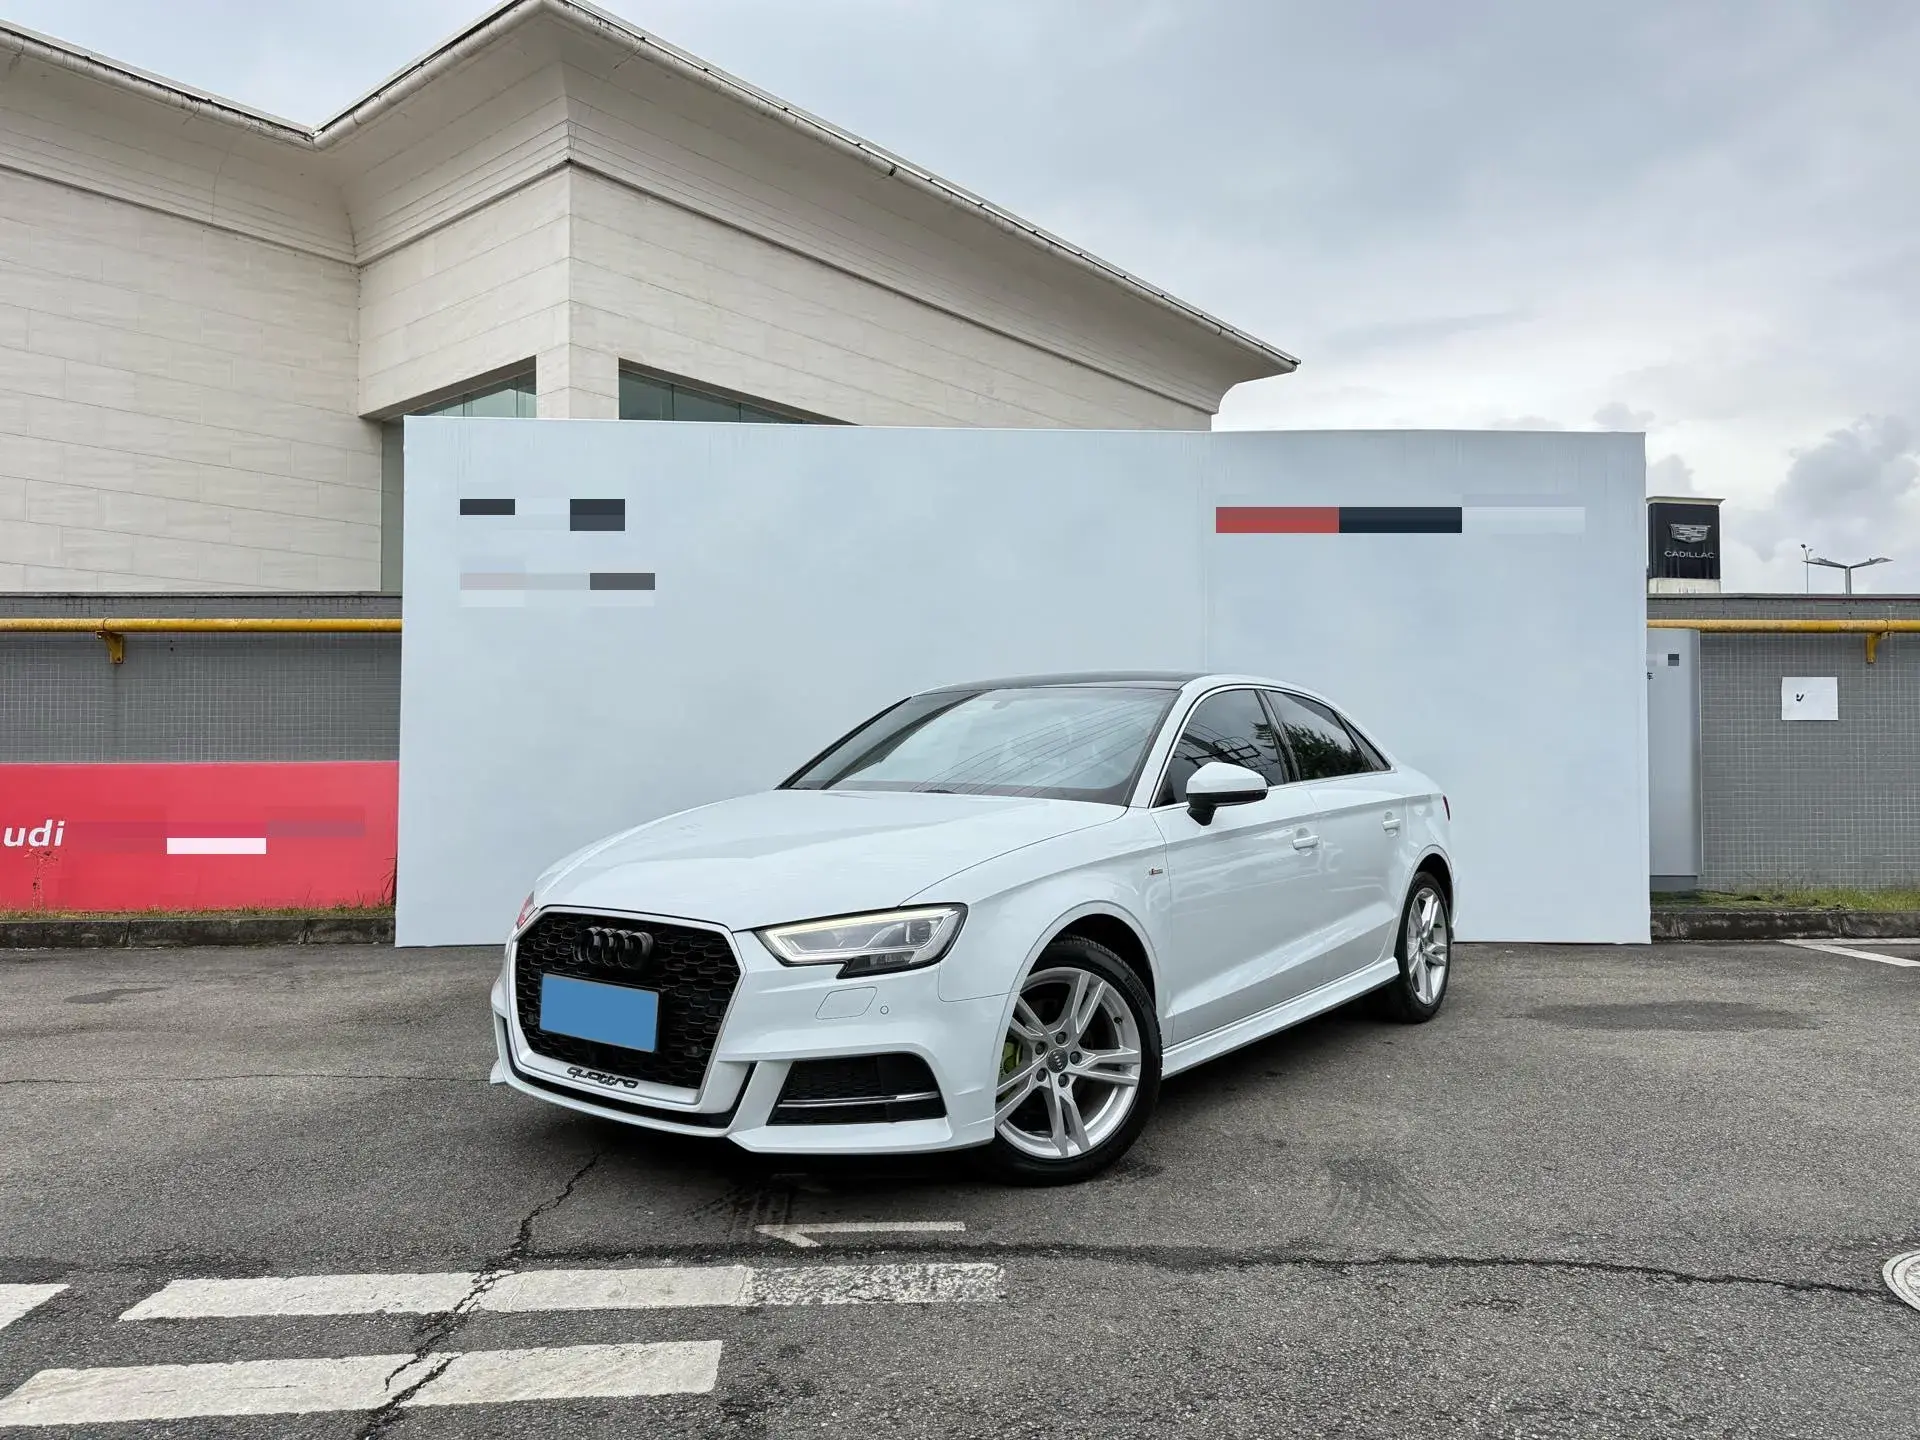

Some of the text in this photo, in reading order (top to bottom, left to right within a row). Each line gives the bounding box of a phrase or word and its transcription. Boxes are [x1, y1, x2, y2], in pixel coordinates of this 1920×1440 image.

[1664, 550, 1715, 559] CADILLAC
[3, 819, 65, 847] udi
[566, 1066, 639, 1089] quattro
